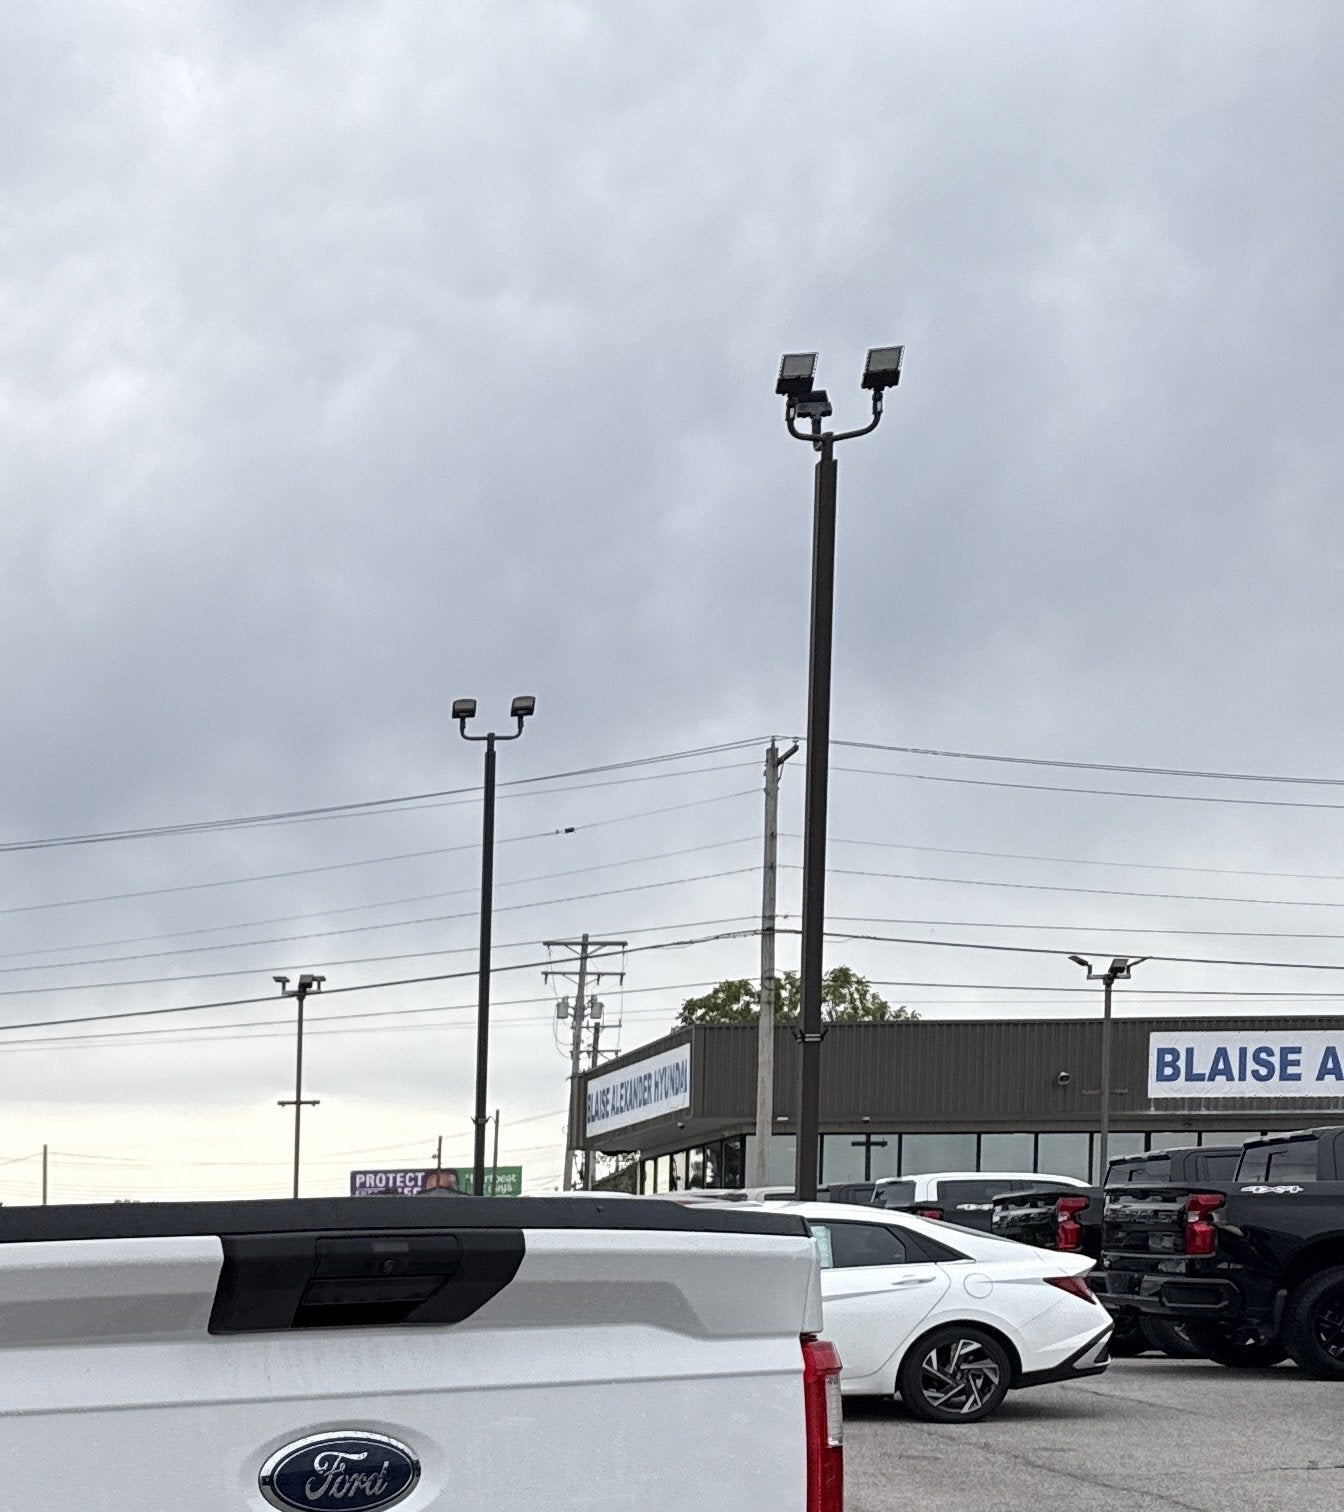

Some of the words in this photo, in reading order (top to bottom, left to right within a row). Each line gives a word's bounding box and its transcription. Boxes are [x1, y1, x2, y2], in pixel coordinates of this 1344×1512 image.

[1156, 1046, 1302, 1082] BLAISE
[587, 1087, 610, 1124] BLAISE
[611, 1072, 652, 1117] ALEXANDER
[653, 1058, 688, 1103] HYUNDAI
[355, 1171, 425, 1188] PROTECT
[305, 1451, 389, 1501] Ford
